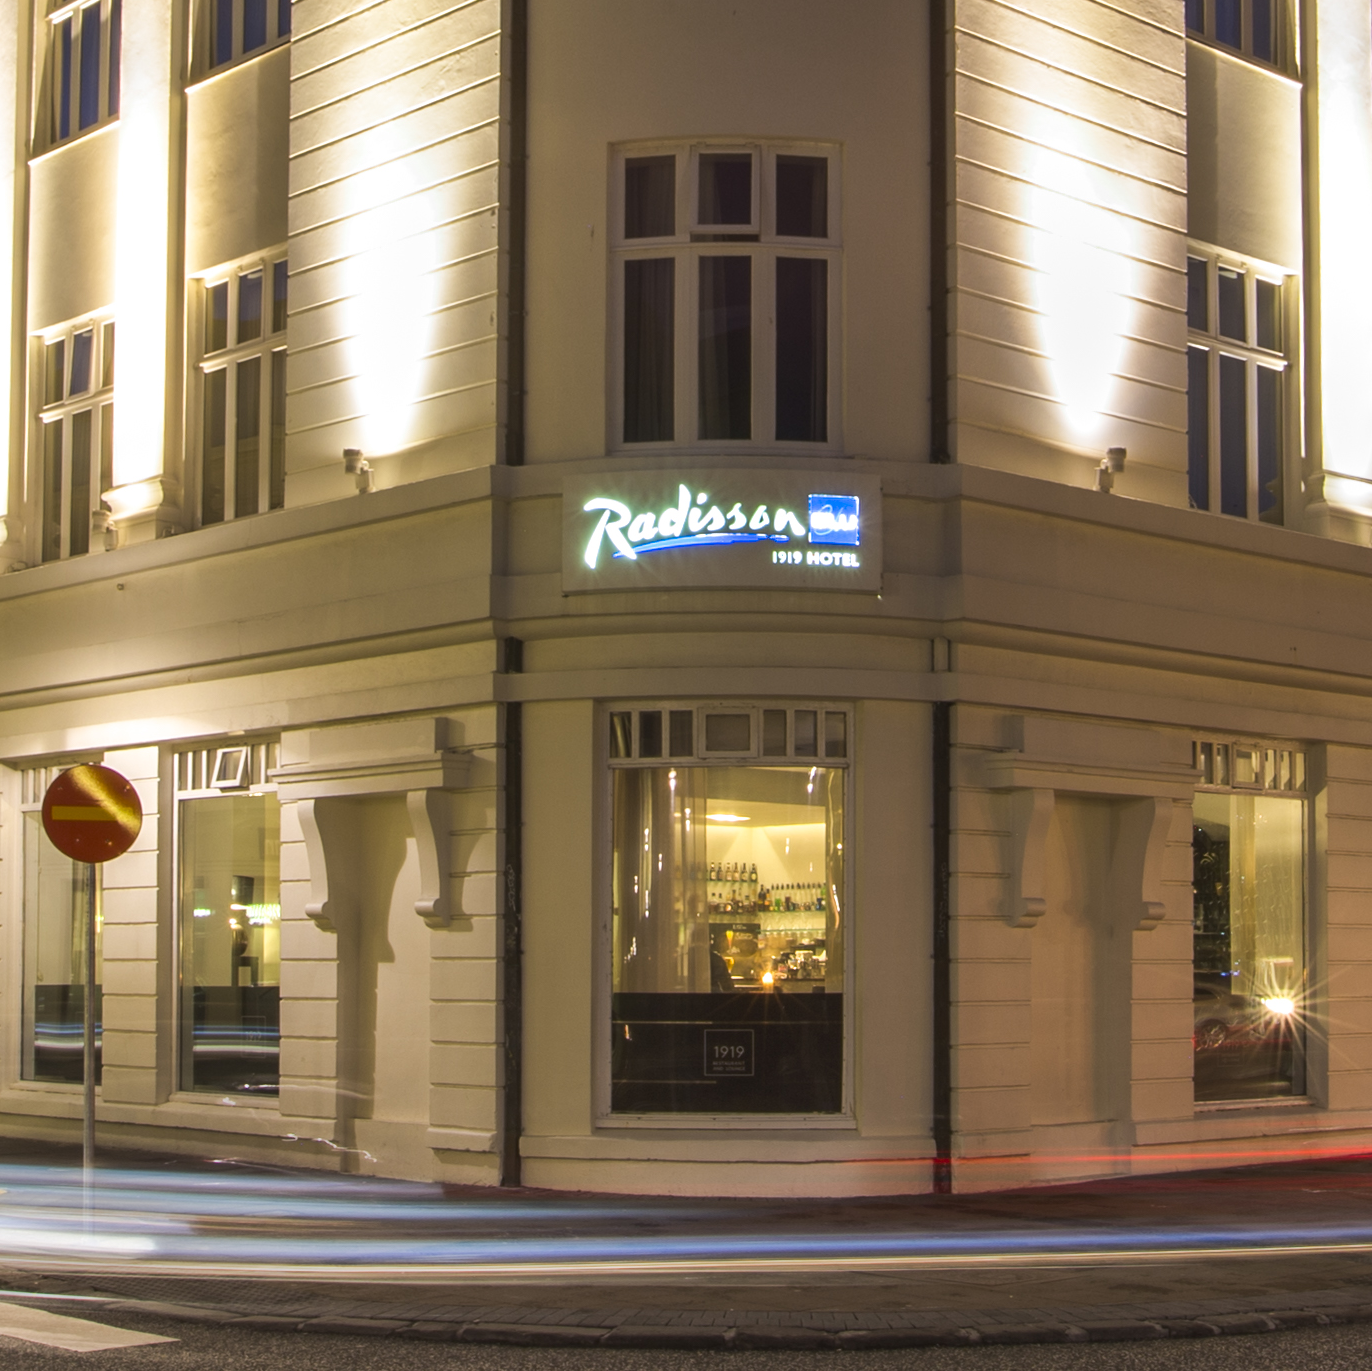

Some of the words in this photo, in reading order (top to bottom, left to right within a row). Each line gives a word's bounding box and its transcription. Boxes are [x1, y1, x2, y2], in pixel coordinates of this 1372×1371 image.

[583, 484, 806, 569] Radisson
[772, 551, 803, 565] 1919
[806, 551, 860, 568] HOTEL
[714, 1045, 745, 1058] 1919
